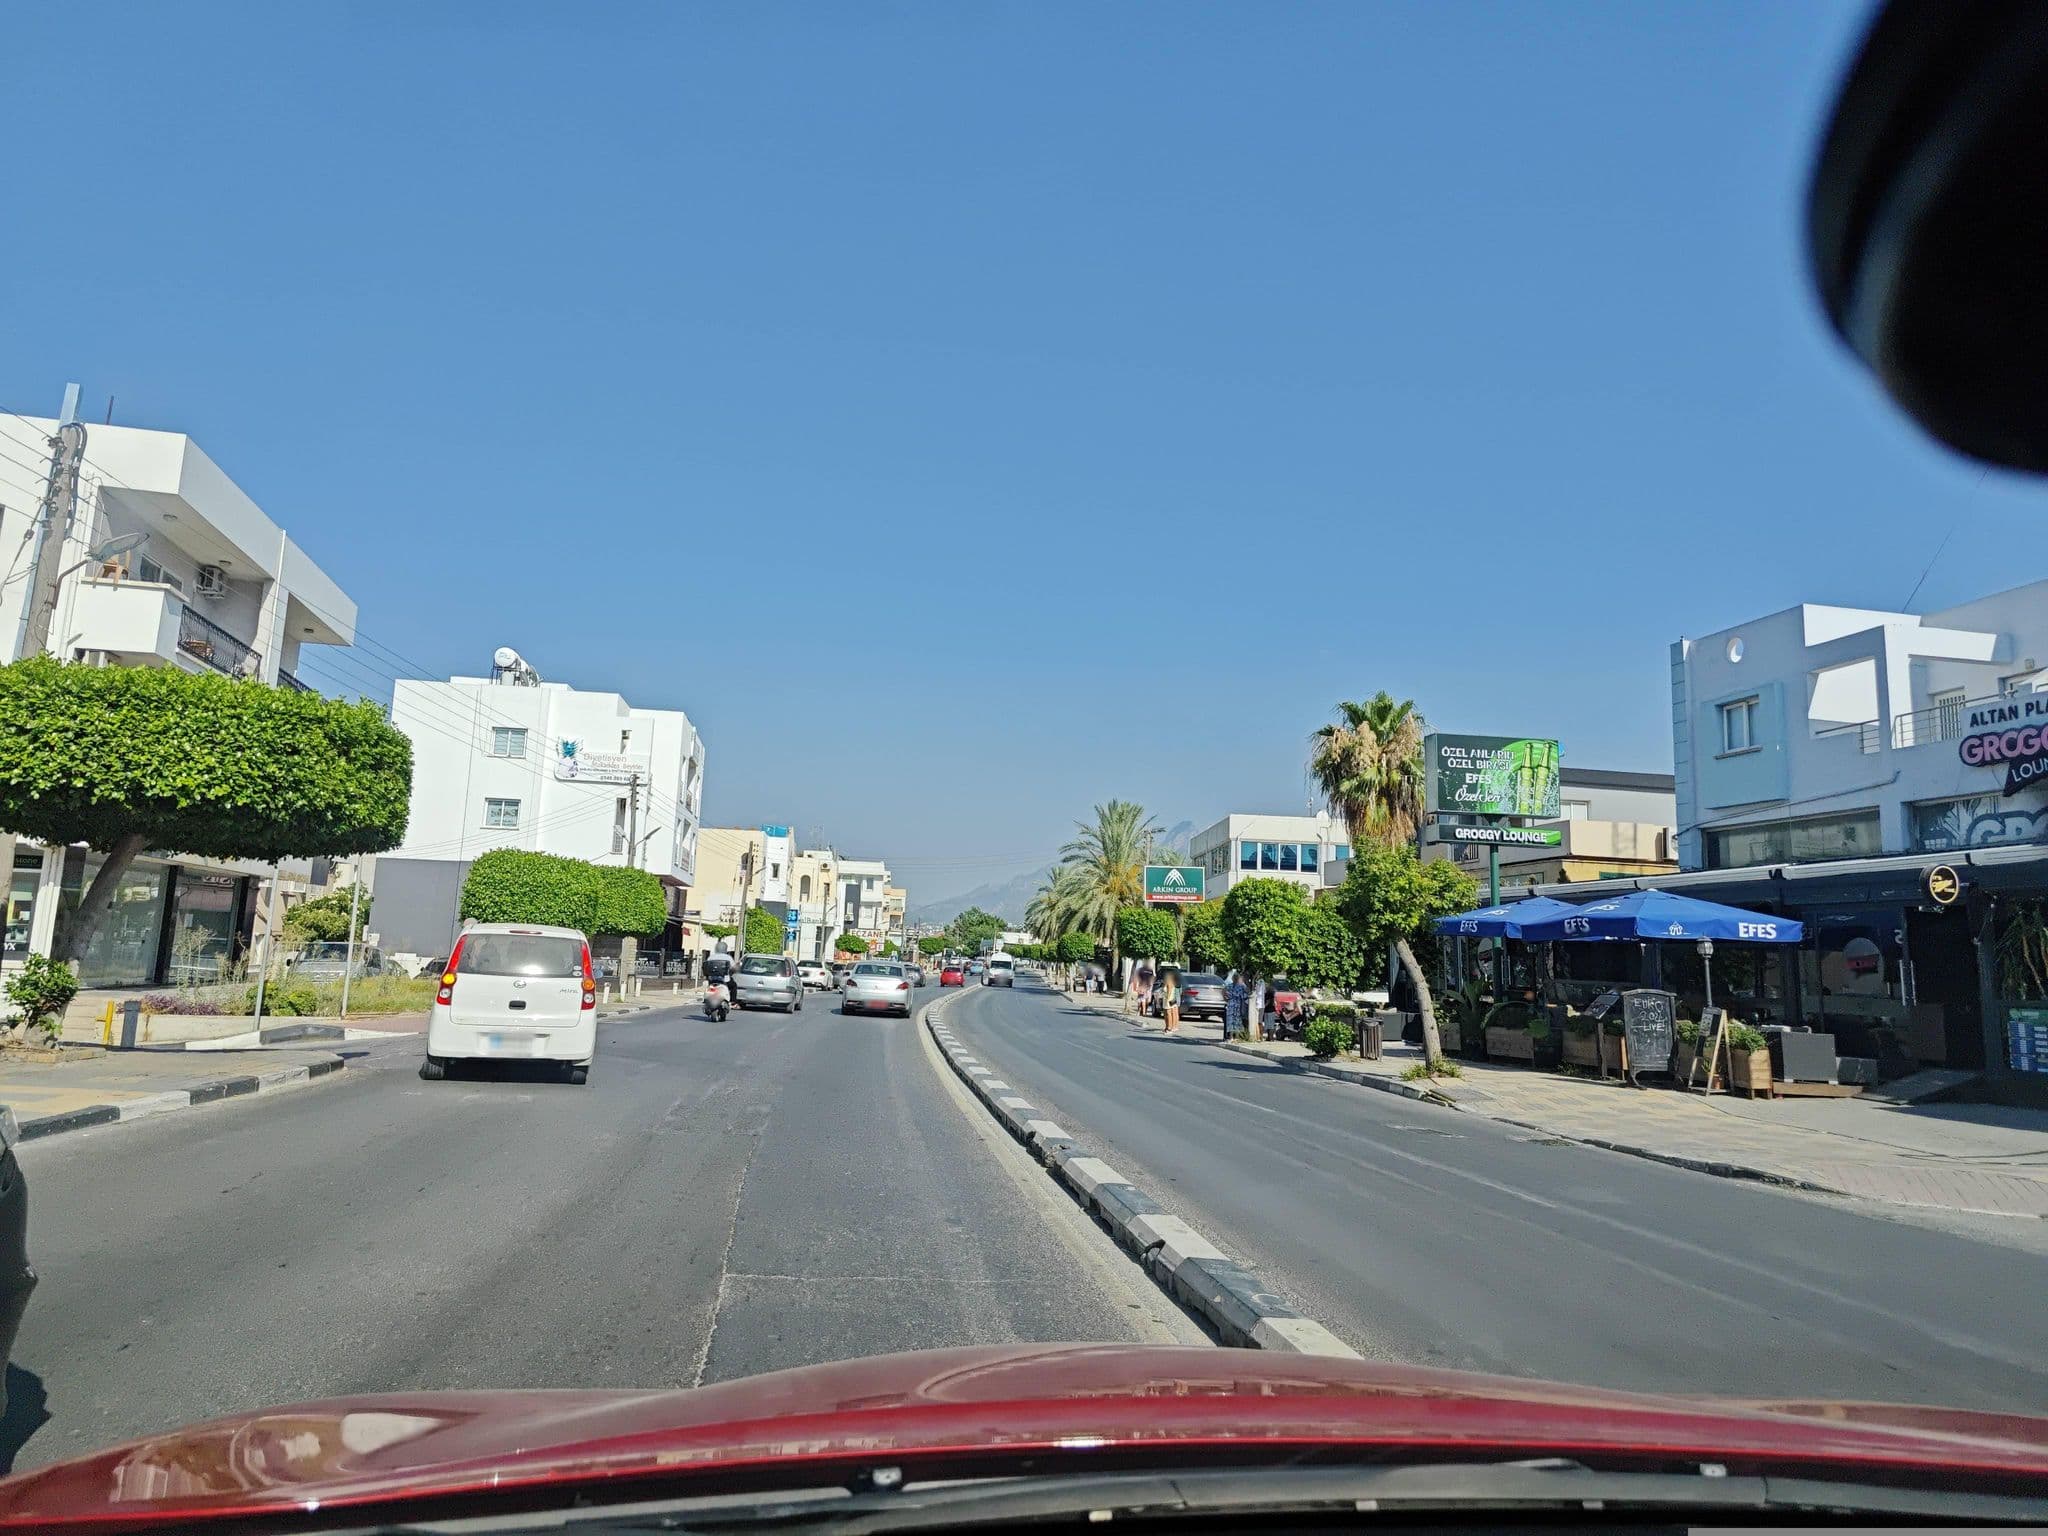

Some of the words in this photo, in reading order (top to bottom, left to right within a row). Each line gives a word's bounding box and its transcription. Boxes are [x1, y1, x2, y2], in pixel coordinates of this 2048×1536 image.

[1970, 704, 2019, 728] ALTAN
[1441, 746, 1469, 758] ÖZEL
[1448, 758, 1474, 769] ÖZEL
[1465, 773, 1492, 784] EFES
[1455, 828, 1501, 840] GROGGY
[1503, 830, 1548, 843] LOUNGE
[1175, 886, 1198, 894] GROUP
[1460, 919, 1479, 933] EFES
[1564, 917, 1591, 934] EFES
[1738, 922, 1777, 939] EFES
